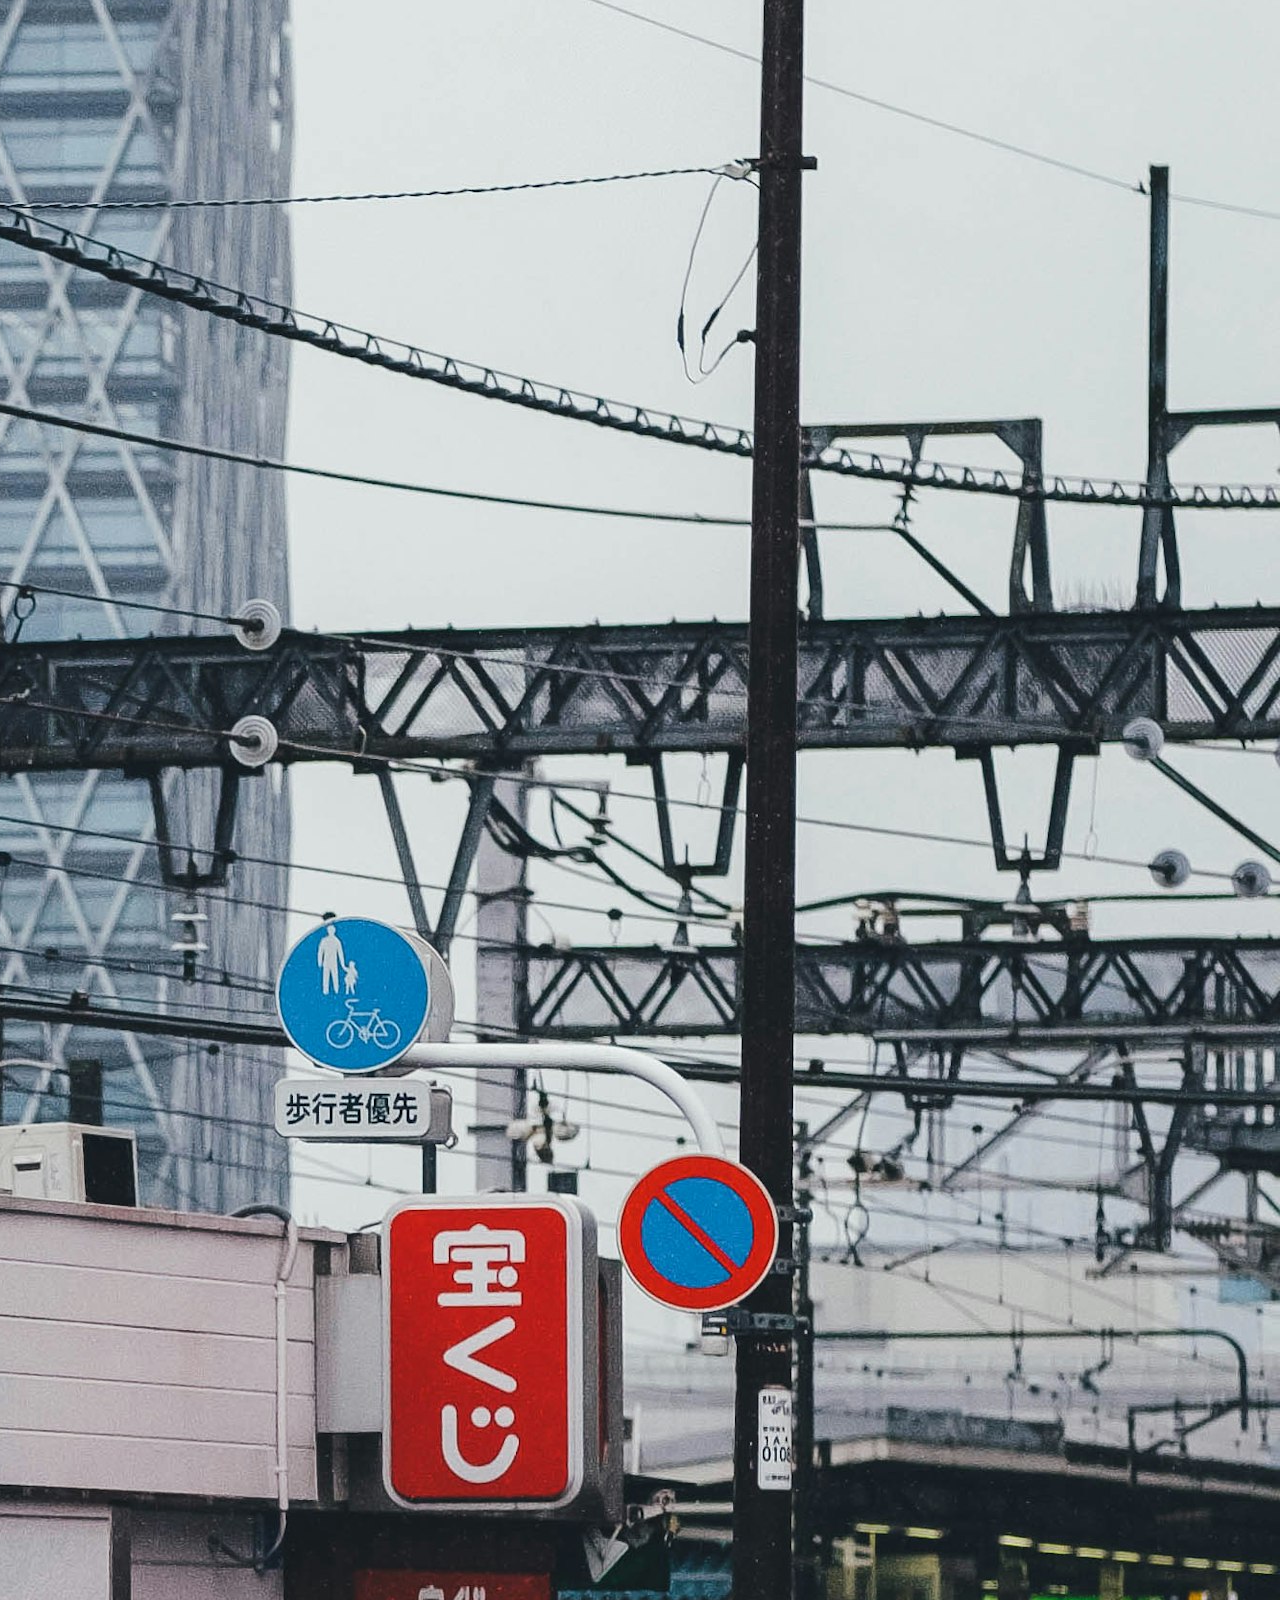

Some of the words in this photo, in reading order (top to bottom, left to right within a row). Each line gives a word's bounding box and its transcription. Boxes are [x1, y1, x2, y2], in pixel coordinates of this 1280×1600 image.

[286, 1092, 418, 1125] 歩行者優先
[433, 1223, 526, 1484] 宝くじ
